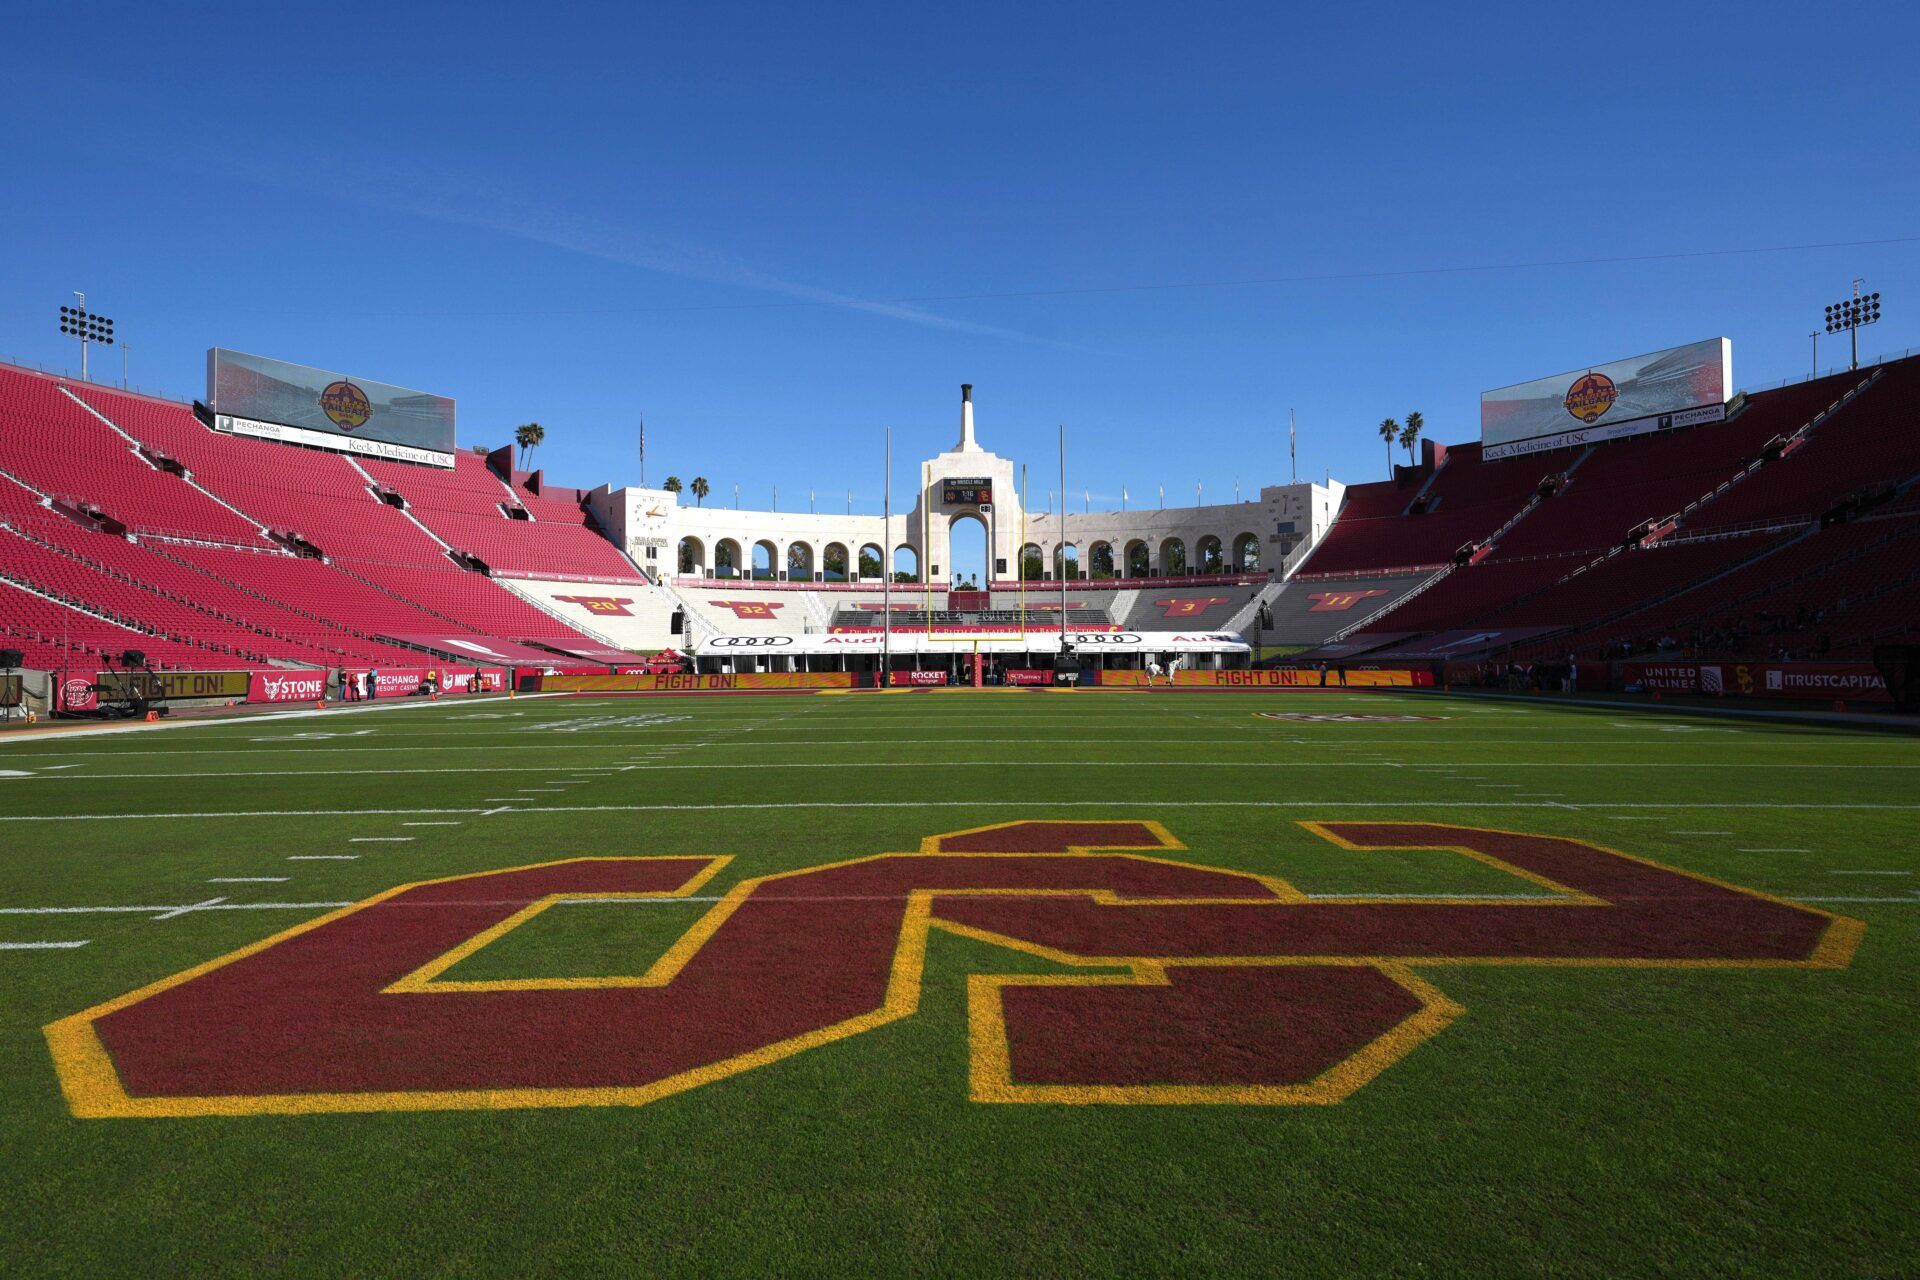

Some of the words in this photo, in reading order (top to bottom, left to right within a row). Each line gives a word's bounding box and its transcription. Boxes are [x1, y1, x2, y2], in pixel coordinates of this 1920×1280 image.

[1674, 408, 1720, 421] PECHANGA
[236, 420, 281, 433] PECHANGA
[1484, 448, 1509, 459] Keck
[1510, 440, 1551, 455] Medicine
[1552, 435, 1564, 447] of
[1566, 432, 1590, 443] USC
[348, 439, 373, 453] Keck
[376, 443, 418, 461] Medicine
[419, 451, 430, 462] of
[431, 453, 453, 465] USC
[587, 601, 619, 611] 20
[739, 605, 767, 614] 32
[1180, 603, 1195, 611] 3
[823, 636, 884, 644] Audi
[1215, 671, 1263, 684] FIGHT
[1269, 670, 1298, 684] ON!
[1645, 668, 1696, 678] UNITED
[193, 674, 224, 694] ON!
[377, 675, 419, 685] PECHANGA
[655, 675, 704, 689] FIGHT
[709, 674, 738, 688] ON!
[1635, 678, 1697, 689] AIRLINES
[281, 680, 322, 694] STONE
[399, 683, 419, 691] CASINO
